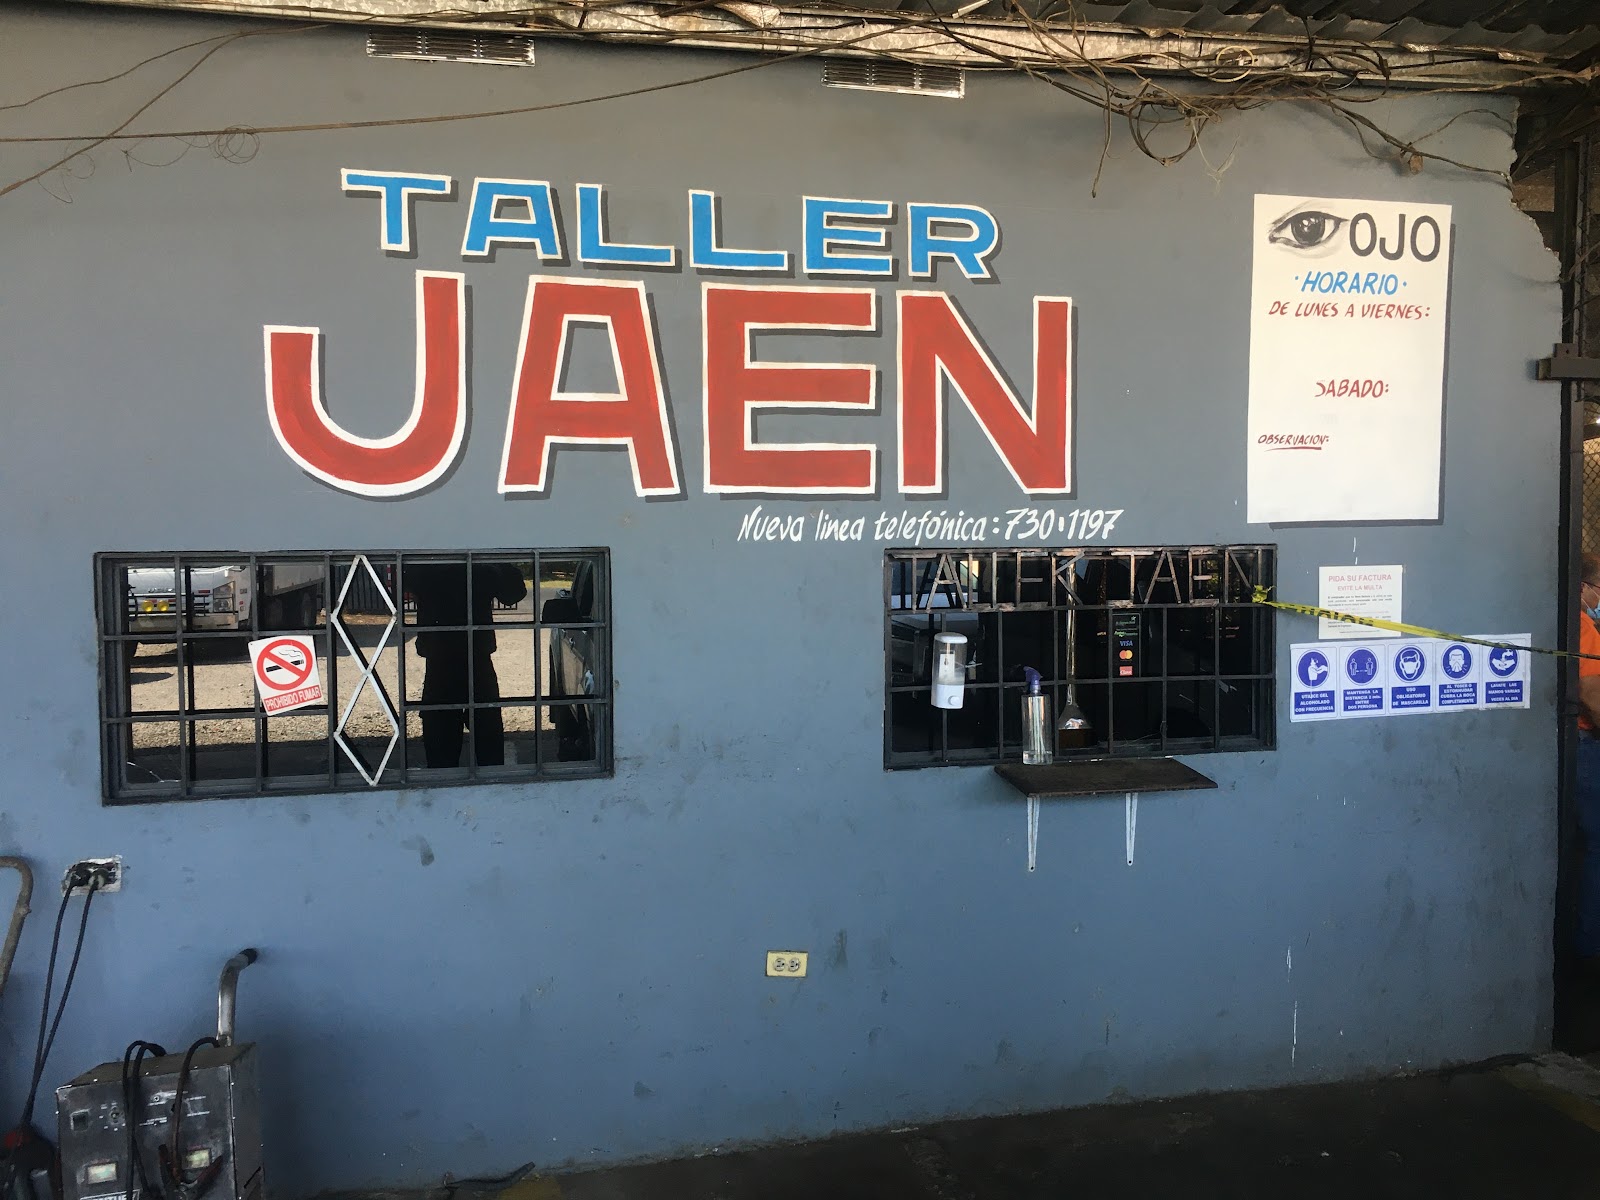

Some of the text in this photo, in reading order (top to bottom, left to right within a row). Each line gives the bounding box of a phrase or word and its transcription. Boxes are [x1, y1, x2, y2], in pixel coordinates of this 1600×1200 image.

[340, 168, 1000, 278] TALLER
[1349, 212, 1441, 262] OJO
[1268, 301, 1431, 320] DE LUNES A VIERNES:
[263, 270, 1075, 498] JAEN
[1314, 379, 1389, 398] SABADO:
[1258, 434, 1330, 446] OBSERVACION:
[737, 505, 805, 542] Nueva
[873, 509, 1000, 546] telefónica:
[265, 686, 320, 711] PROHIBIDO FUMAR
